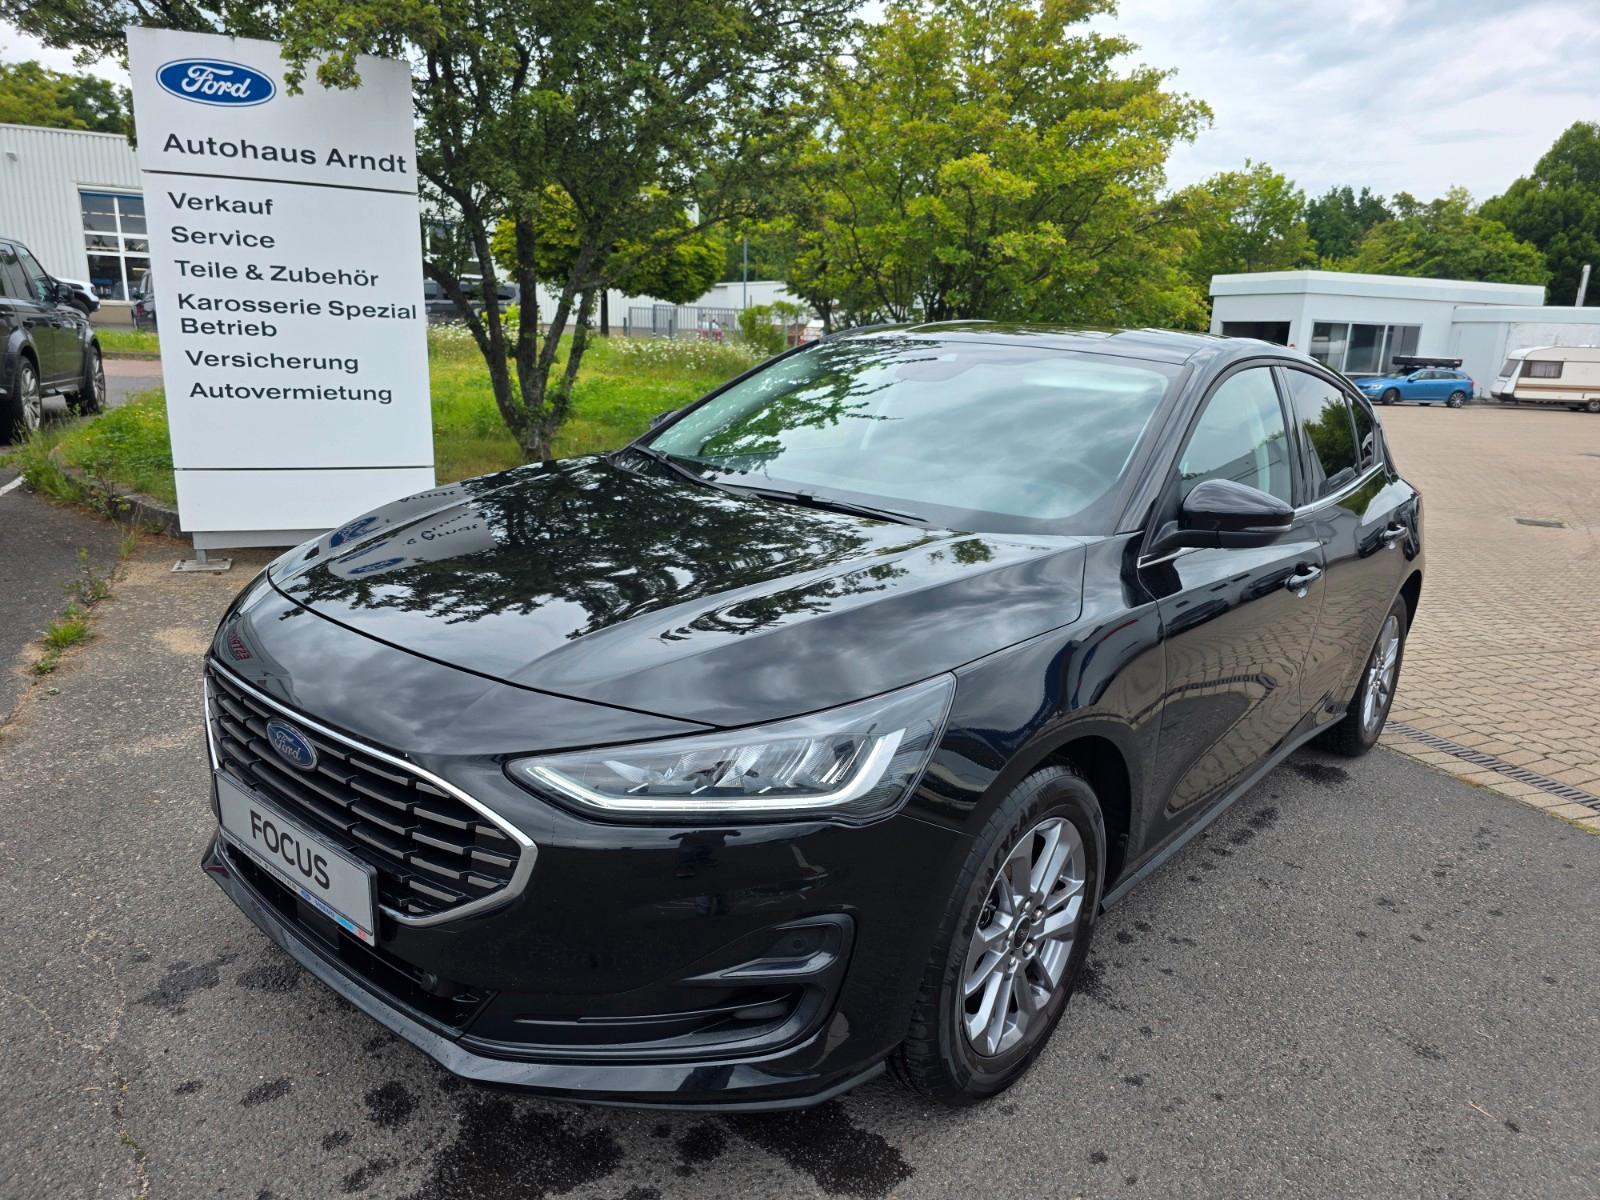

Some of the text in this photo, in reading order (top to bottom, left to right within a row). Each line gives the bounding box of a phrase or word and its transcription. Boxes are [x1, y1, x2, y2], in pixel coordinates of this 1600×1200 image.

[180, 65, 251, 98] Ford
[163, 133, 407, 174] Autohaus Arndt
[168, 191, 274, 215] Verkauf
[171, 226, 275, 249] Service
[174, 259, 379, 287] Teile & Zubehör
[177, 293, 417, 321] Karosserie Spezial
[180, 317, 277, 337] Betrieb
[184, 350, 359, 375] Versicherung
[189, 382, 392, 405] Autovermietung
[249, 809, 330, 890] FOCUS
